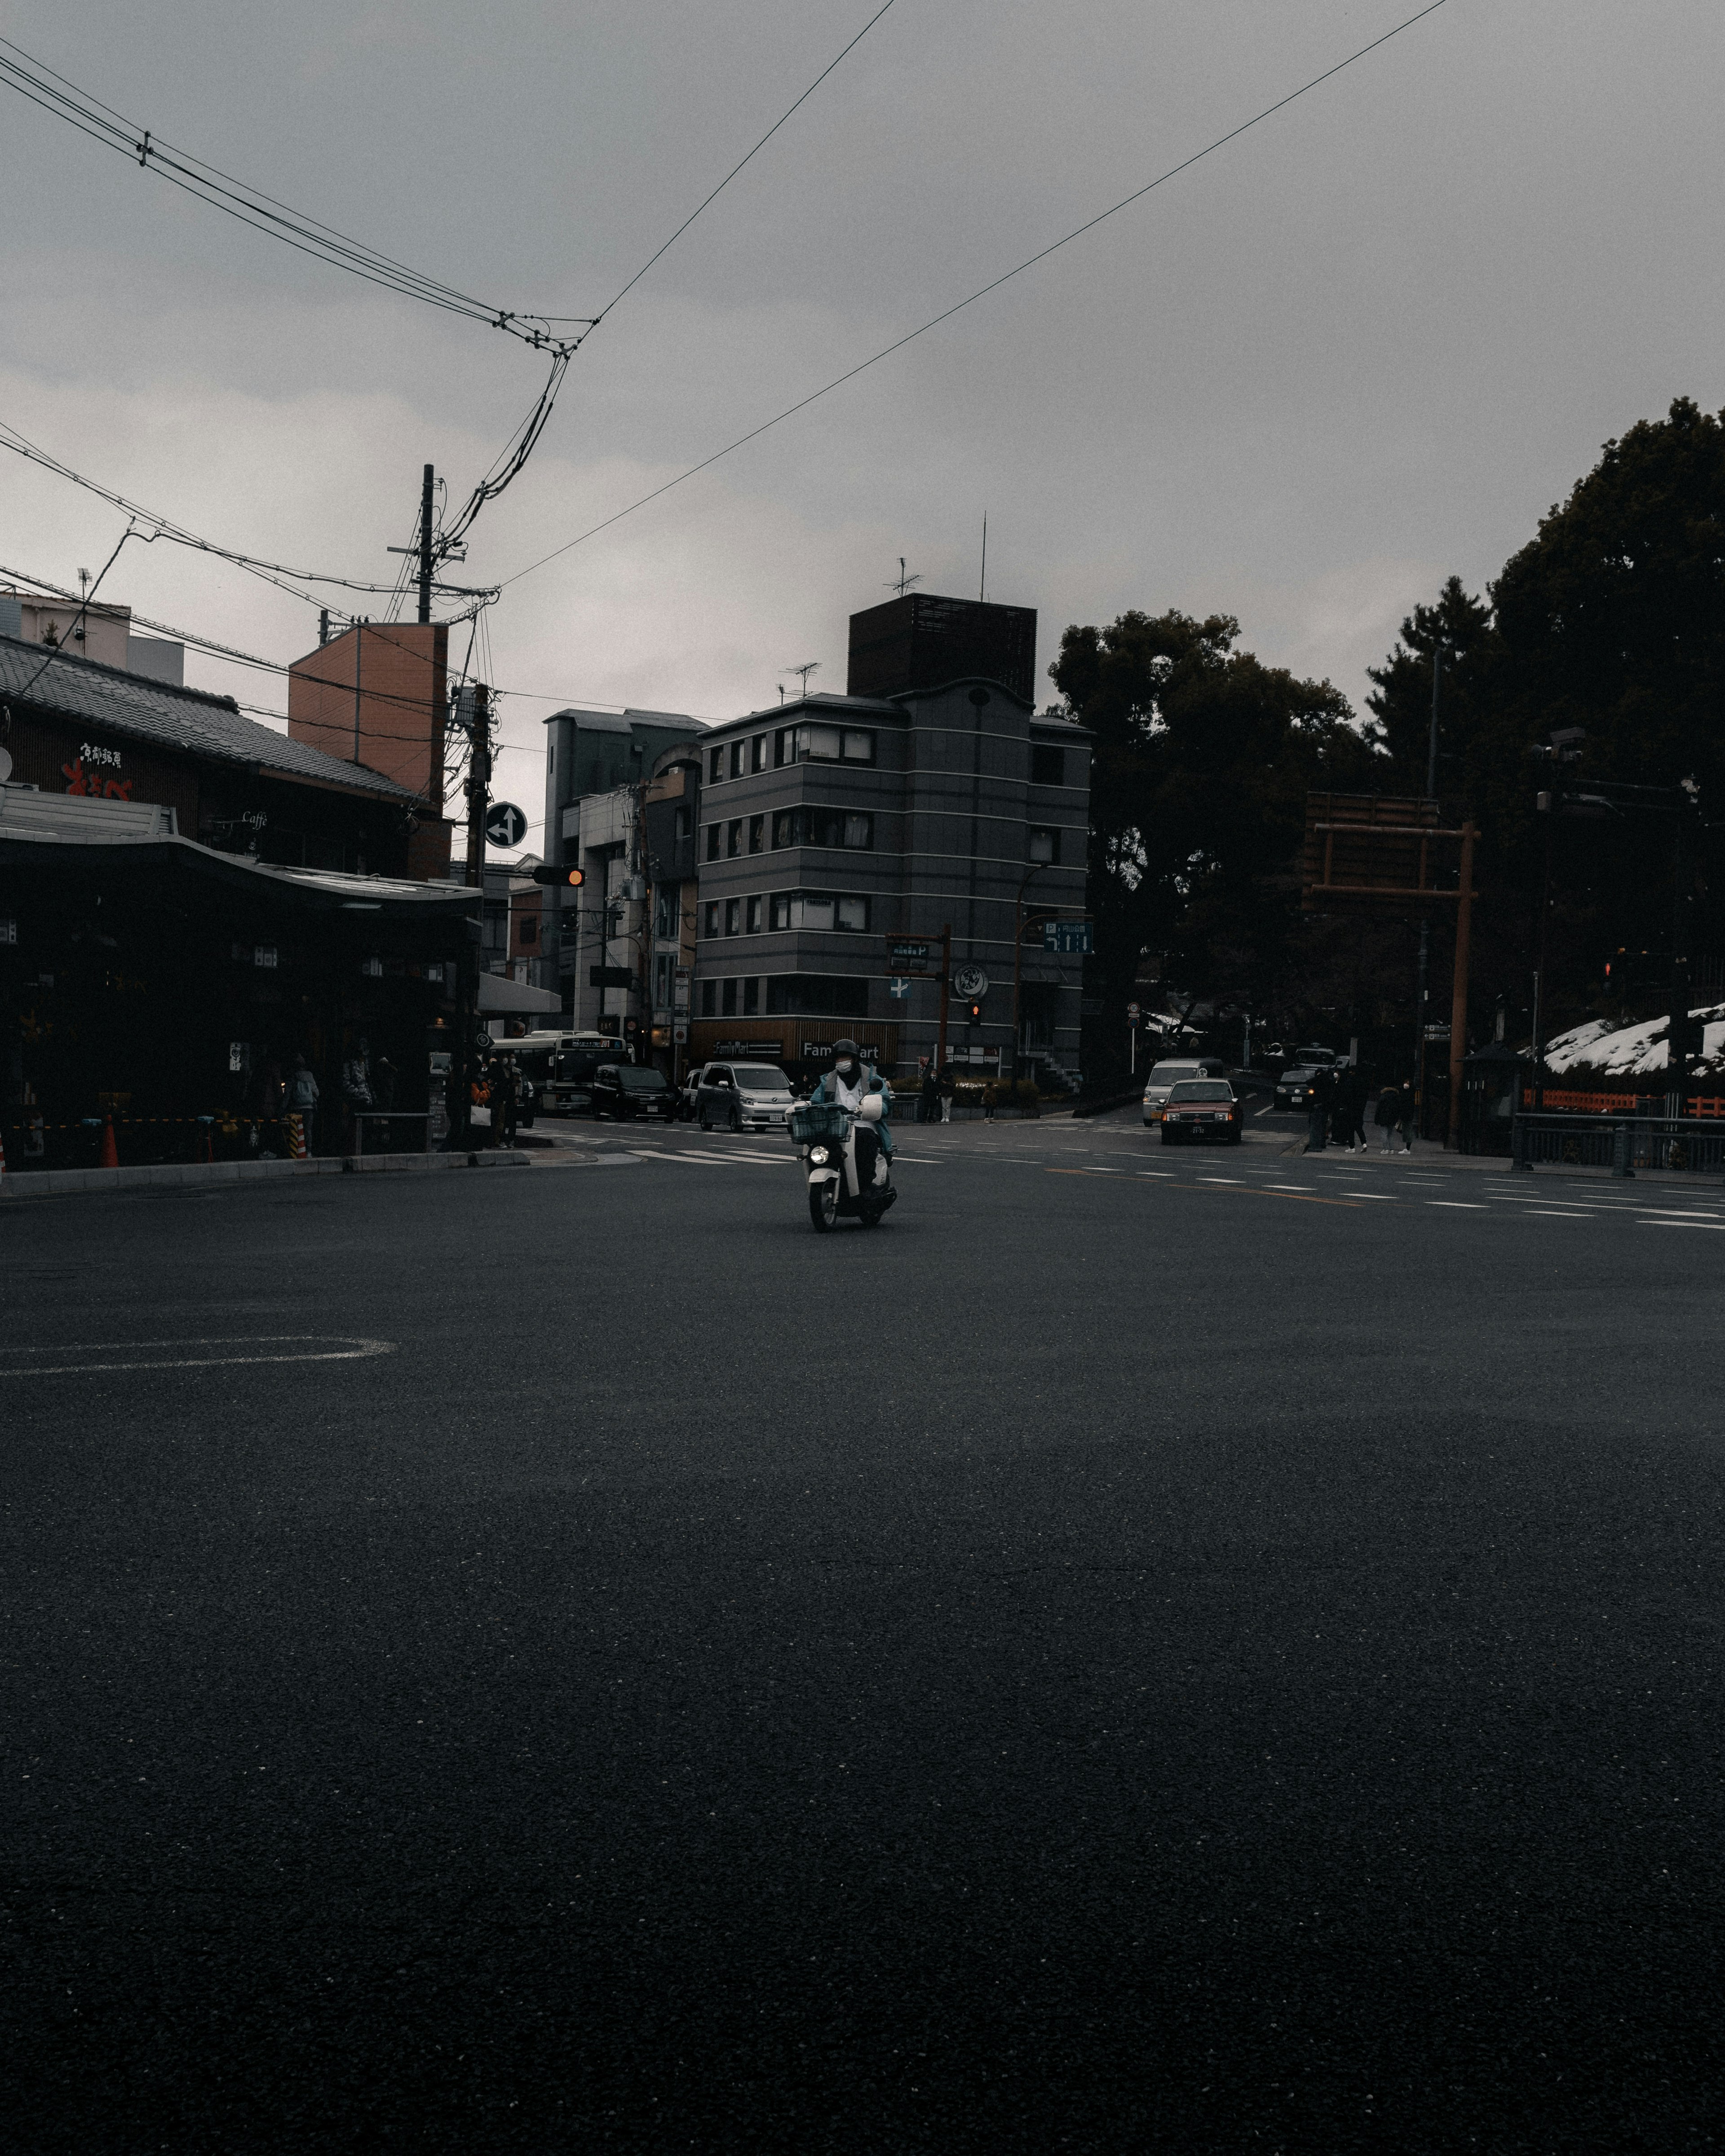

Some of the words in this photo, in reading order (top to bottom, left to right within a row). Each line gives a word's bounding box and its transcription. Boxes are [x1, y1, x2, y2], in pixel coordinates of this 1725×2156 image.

[242, 811, 267, 830] Caffè
[919, 946, 926, 956] P
[716, 1041, 748, 1056] FamilyMart
[804, 1043, 879, 1059] Famart
